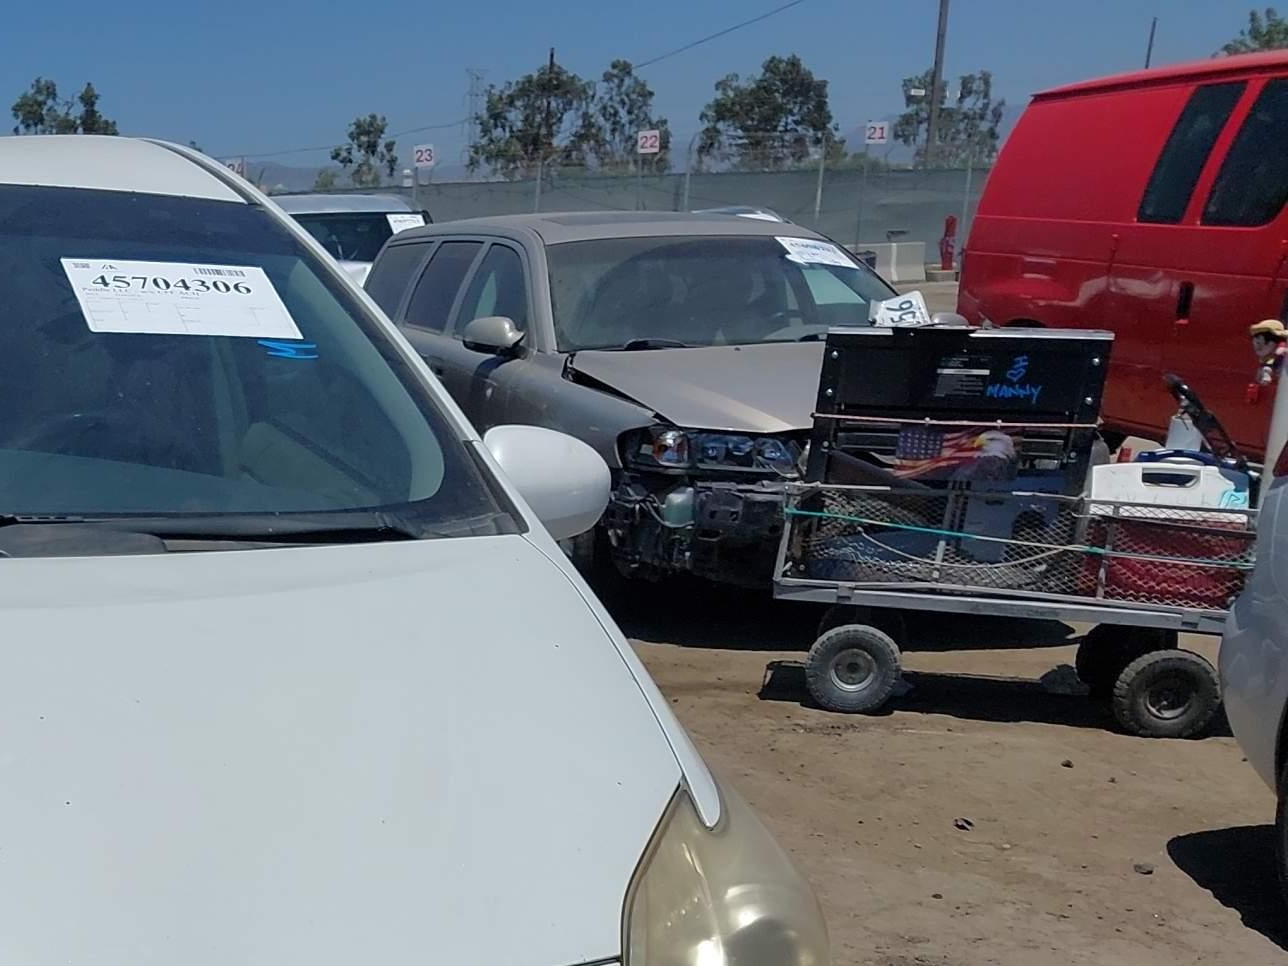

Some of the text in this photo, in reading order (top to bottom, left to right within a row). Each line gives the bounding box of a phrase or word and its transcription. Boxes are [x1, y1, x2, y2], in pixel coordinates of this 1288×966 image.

[867, 126, 886, 140] 21
[639, 134, 658, 149] 22
[415, 149, 433, 163] 23
[91, 275, 252, 295] 45704306
[986, 383, 1042, 404] MANNY
